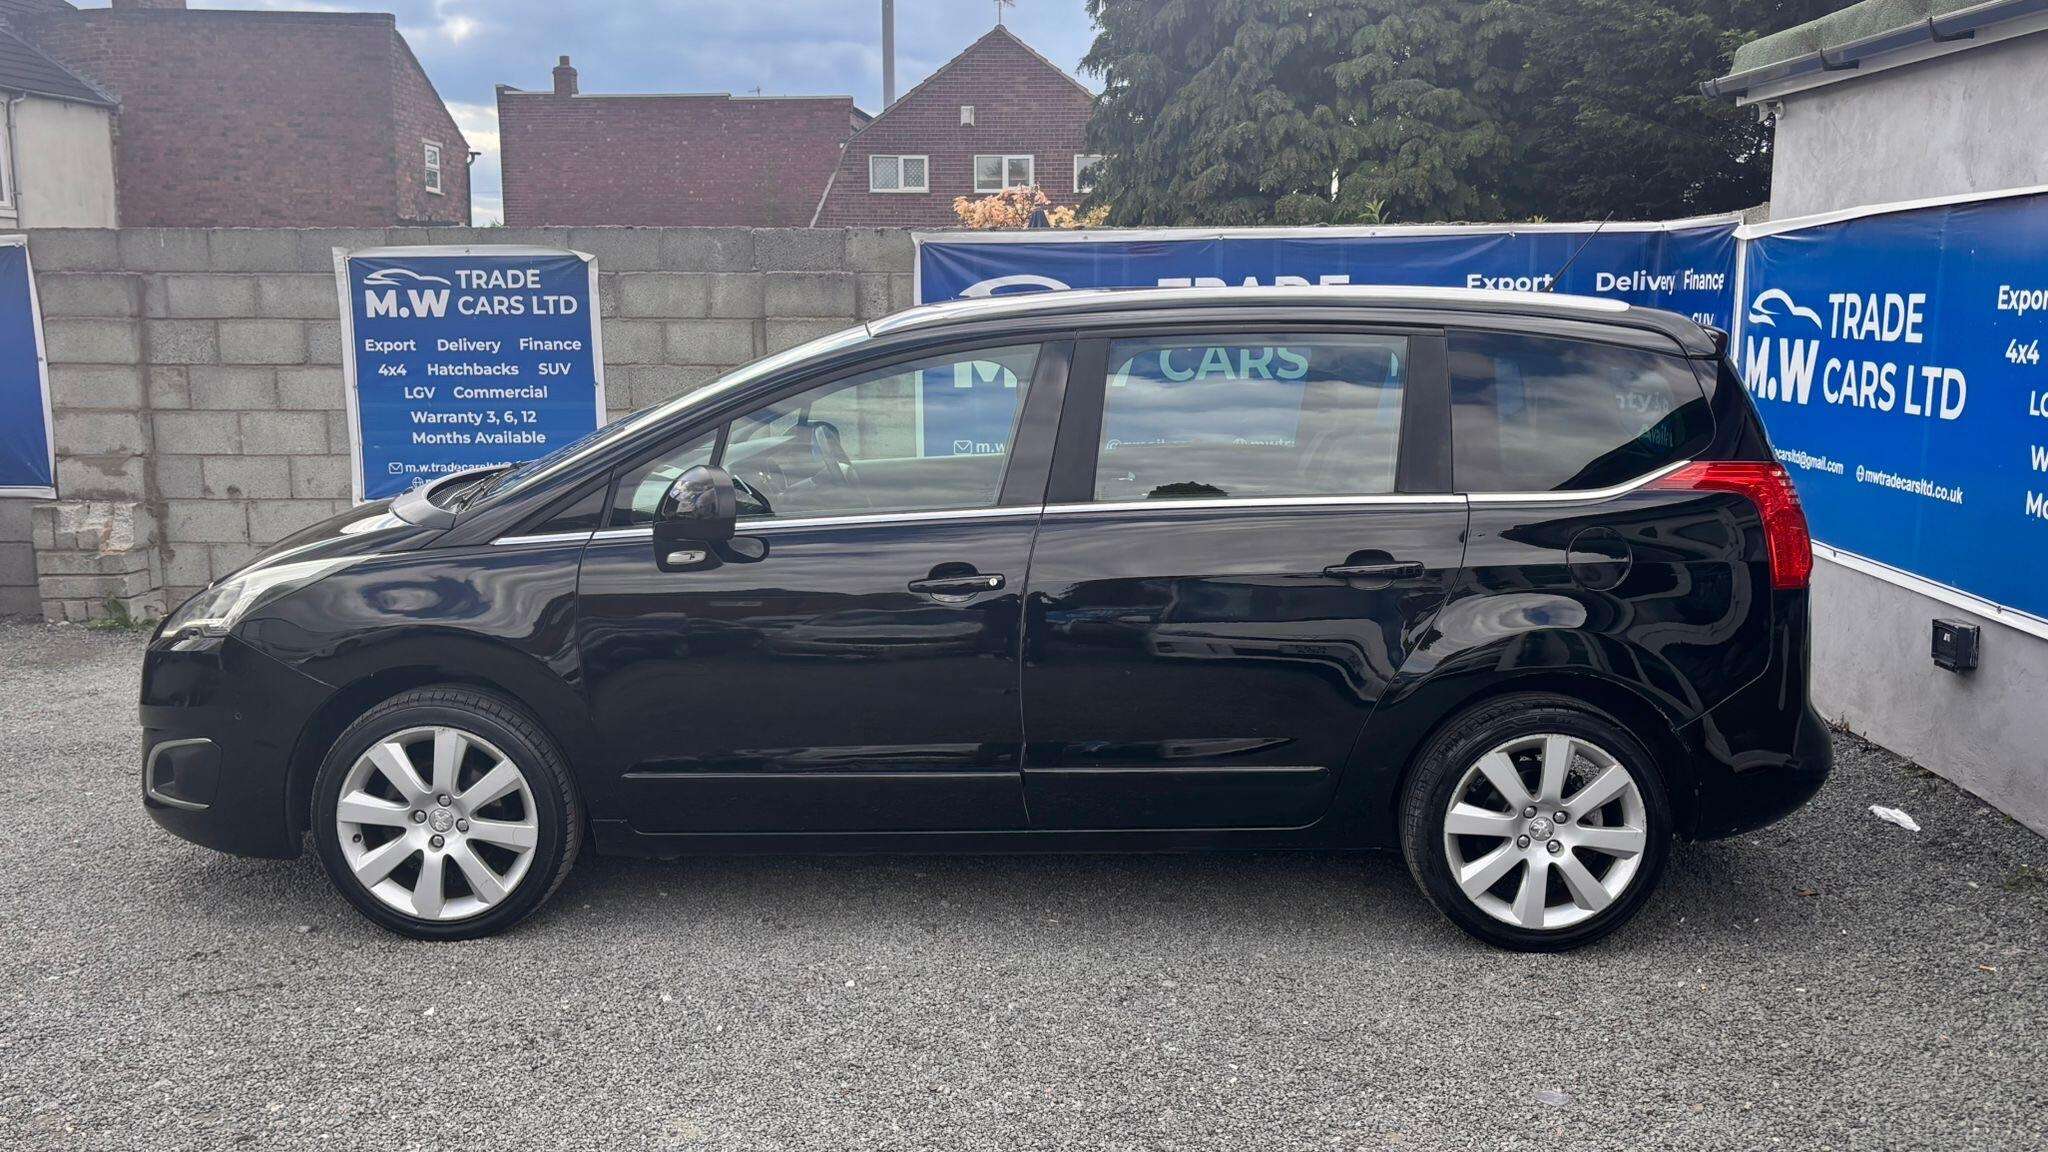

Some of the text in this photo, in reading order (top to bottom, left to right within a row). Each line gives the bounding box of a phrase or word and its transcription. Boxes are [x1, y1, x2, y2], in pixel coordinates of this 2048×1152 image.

[455, 269, 541, 289] TRADE
[1467, 268, 1725, 295] Export Delivery Finance
[365, 289, 450, 318] M.W
[457, 295, 578, 315] CARS LTD
[1997, 285, 2048, 316] Expor
[1828, 293, 1926, 343] TRADE
[365, 337, 582, 353] Export Delivery Finance
[2005, 338, 2040, 365] 4x4
[378, 363, 571, 376] 4x4 Hatchbacks SUV
[1159, 347, 1309, 381] CARS
[1745, 335, 1820, 405] M.W
[404, 386, 548, 399] LGV Commercial
[1823, 357, 1897, 412] CARS
[1904, 364, 1967, 420] LTD
[411, 411, 537, 425] Warranty 3, 6, 12
[412, 431, 546, 444] Months Available
[1775, 448, 1844, 475] carsltd@gmail.com
[1864, 470, 1964, 504] mwtradecarsltd.co.uk
